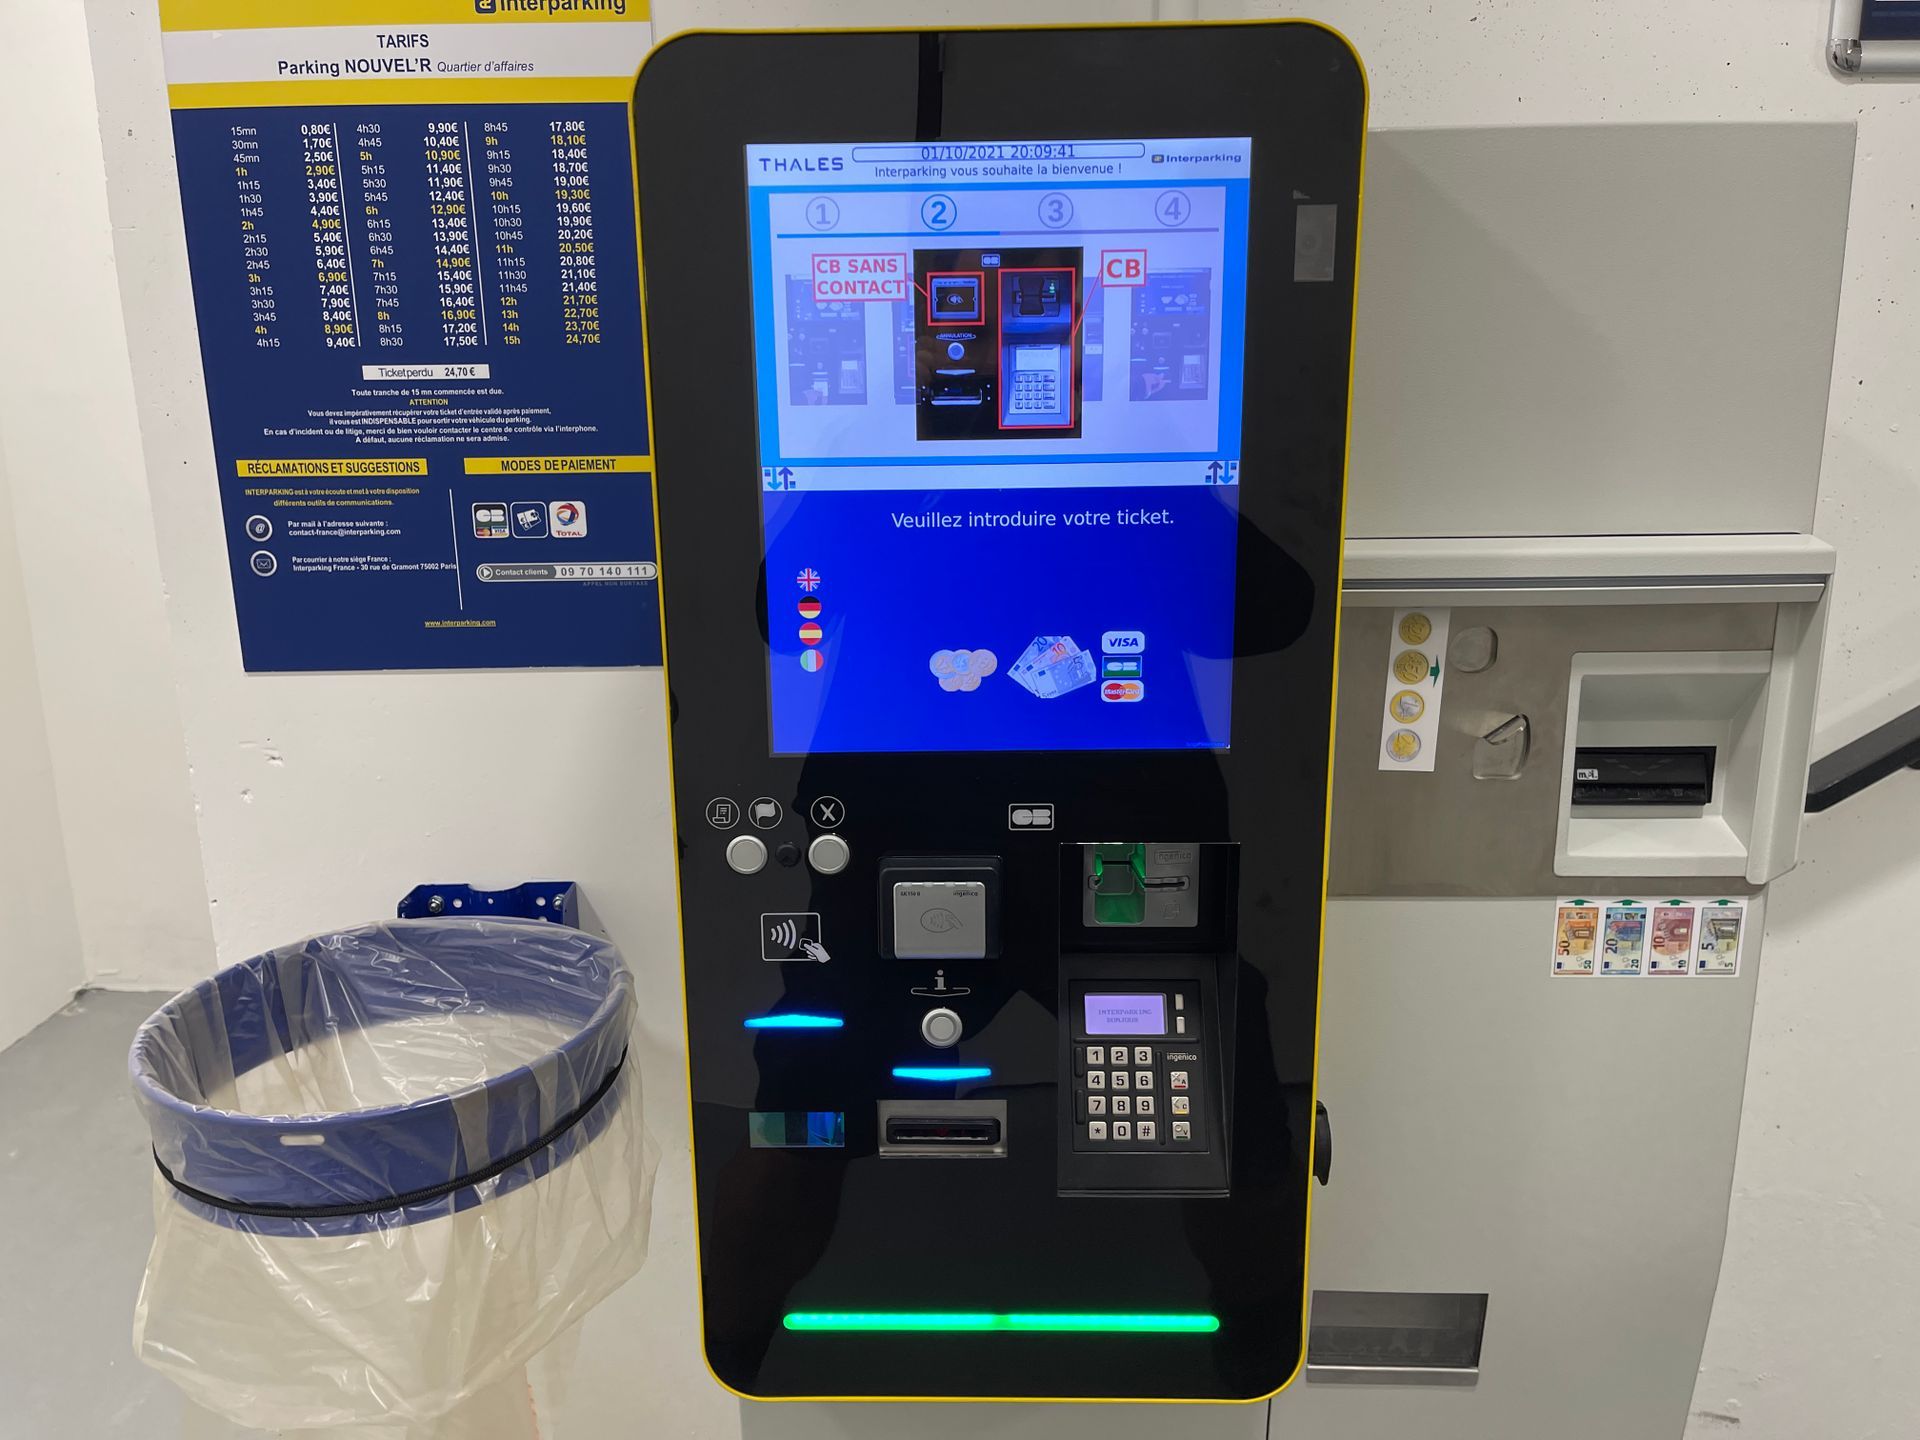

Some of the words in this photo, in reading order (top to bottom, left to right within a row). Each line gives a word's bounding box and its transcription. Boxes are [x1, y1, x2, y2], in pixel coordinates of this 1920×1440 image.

[377, 34, 429, 49] TARIFS
[278, 61, 340, 77] Parking
[437, 62, 481, 73] Quartier
[231, 127, 256, 136] 15mn
[301, 125, 330, 136] 0,80€
[357, 124, 380, 133] 4h30
[428, 123, 457, 134] 9,90€
[484, 123, 508, 132] 8h45
[550, 122, 585, 133] 17,80€
[232, 140, 258, 149] 30mn
[303, 138, 332, 149] 1,70€
[358, 138, 381, 147] 4h45
[424, 136, 459, 148] 10,40€
[486, 137, 498, 146] 9h
[551, 135, 586, 146] 18,10€
[304, 152, 333, 163] 2,50€
[360, 152, 372, 161] 5h
[426, 150, 460, 161] 10,90€
[487, 150, 510, 159] 9h15
[552, 149, 587, 160] 18,40€
[921, 146, 1004, 161] 01/10/2021
[1011, 144, 1075, 158] 20:09:41
[233, 154, 259, 163] 45mn
[1167, 154, 1241, 163] Interparking
[488, 164, 511, 173] 9h30
[553, 163, 588, 173] 18,70€
[759, 157, 843, 171] THALES
[235, 168, 247, 176] 1h
[306, 165, 335, 176] 2,90€
[361, 165, 385, 174] 5h15
[427, 164, 462, 175] 11,40€
[875, 165, 946, 179] Interparking
[951, 168, 978, 176] vous
[982, 164, 1033, 177] souhaite
[1037, 164, 1047, 175] la
[1052, 163, 1113, 174] bienvenue
[238, 180, 260, 190] 1h15
[308, 179, 336, 190] 3,40€
[363, 179, 386, 188] 5h30
[428, 178, 463, 188] 11,90€
[489, 178, 512, 186] 9h45
[554, 176, 589, 187] 19,00€
[239, 194, 261, 203] 1h30
[309, 193, 338, 203] 3,90€
[365, 192, 387, 201] 5h45
[429, 191, 464, 202] 12,40€
[491, 191, 508, 200] 10h
[556, 190, 590, 201] 19,30€
[241, 207, 263, 217] 1h45
[311, 206, 339, 217] 4,40€
[366, 206, 378, 215] 6h
[431, 205, 466, 216] 12,90€
[492, 205, 520, 213] 10h15
[556, 203, 591, 214] 19,60€
[932, 201, 946, 224] 2
[1048, 200, 1063, 222] 3
[1164, 197, 1181, 219] 4
[816, 204, 831, 224] 1
[242, 221, 254, 230] 2h
[312, 219, 341, 230] 4,90€
[367, 219, 390, 228] 6h15
[432, 218, 467, 229] 13,40€
[494, 218, 522, 227] 10h30
[557, 216, 592, 227] 19,90€
[243, 234, 267, 244] 2h15
[314, 232, 343, 245] 5,40€
[369, 232, 392, 242] 6h30
[433, 231, 468, 244] 13,90€
[494, 231, 523, 241] 10h45
[558, 229, 593, 242] 20,20€
[817, 260, 840, 274] CB
[848, 258, 897, 273] SANS
[1106, 259, 1140, 278] CB
[817, 280, 904, 295] CONTACT
[445, 368, 468, 377] 24,70
[469, 367, 475, 376] €
[248, 459, 327, 475] RÉCLAMATIONS
[329, 462, 342, 474] ET
[345, 461, 420, 474] SUGGESTIONS
[501, 460, 541, 471] MODES
[545, 460, 559, 470] DE
[562, 459, 615, 470] PAIEMENT
[891, 512, 962, 528] Veuillez
[968, 511, 1056, 527] introduire
[1063, 512, 1111, 526] votre
[1117, 509, 1175, 525] ticket.
[293, 564, 332, 572] Interparking
[561, 567, 574, 576] 09
[580, 567, 593, 576] 70
[600, 567, 621, 576] 140
[627, 566, 647, 576] 111
[424, 619, 496, 627] www.interparking.com
[1109, 638, 1139, 647] VISA
[1605, 938, 1618, 954] 20
[1653, 936, 1665, 949] 10
[1558, 941, 1570, 956] 50
[1093, 1051, 1099, 1061] 1
[1116, 1051, 1123, 1061] 2
[1140, 1051, 1147, 1061] 3
[1167, 1053, 1197, 1061] ingenico
[1092, 1076, 1100, 1085] 4
[1116, 1076, 1124, 1086] 5
[1140, 1076, 1148, 1086] 6
[1093, 1101, 1101, 1111] 7
[1117, 1101, 1125, 1111] 8
[1142, 1101, 1150, 1111] 9
[1118, 1126, 1126, 1136] 0
